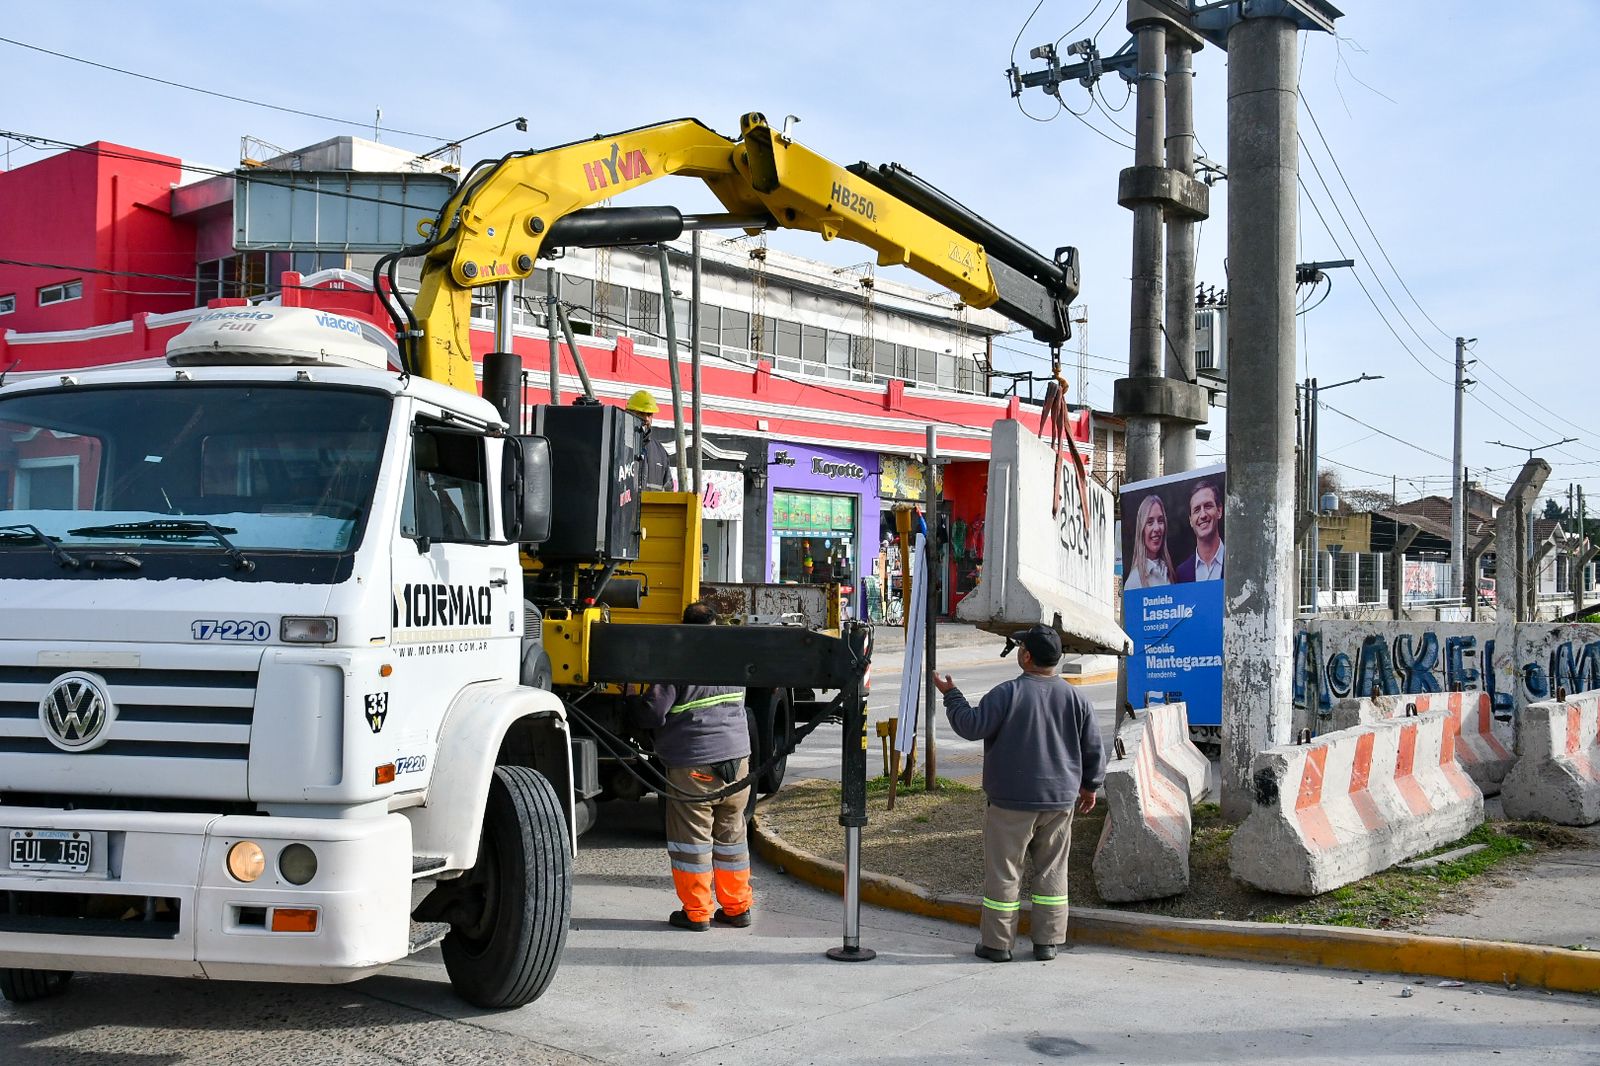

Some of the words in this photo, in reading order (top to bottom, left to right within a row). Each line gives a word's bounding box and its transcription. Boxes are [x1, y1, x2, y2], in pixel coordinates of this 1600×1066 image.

[583, 142, 653, 191] HYVA
[480, 260, 511, 277] HYVA
[218, 321, 257, 332] Full
[811, 456, 864, 479] Koyotte
[393, 583, 492, 628] MORMAQ
[1143, 595, 1173, 607] Daniela
[1143, 604, 1193, 622] Lassalle
[1144, 643, 1175, 655] Nicolás
[1146, 655, 1222, 671] Mantegazza
[368, 692, 386, 715] 33
[13, 840, 46, 861] EUL
[58, 841, 88, 864] 156
